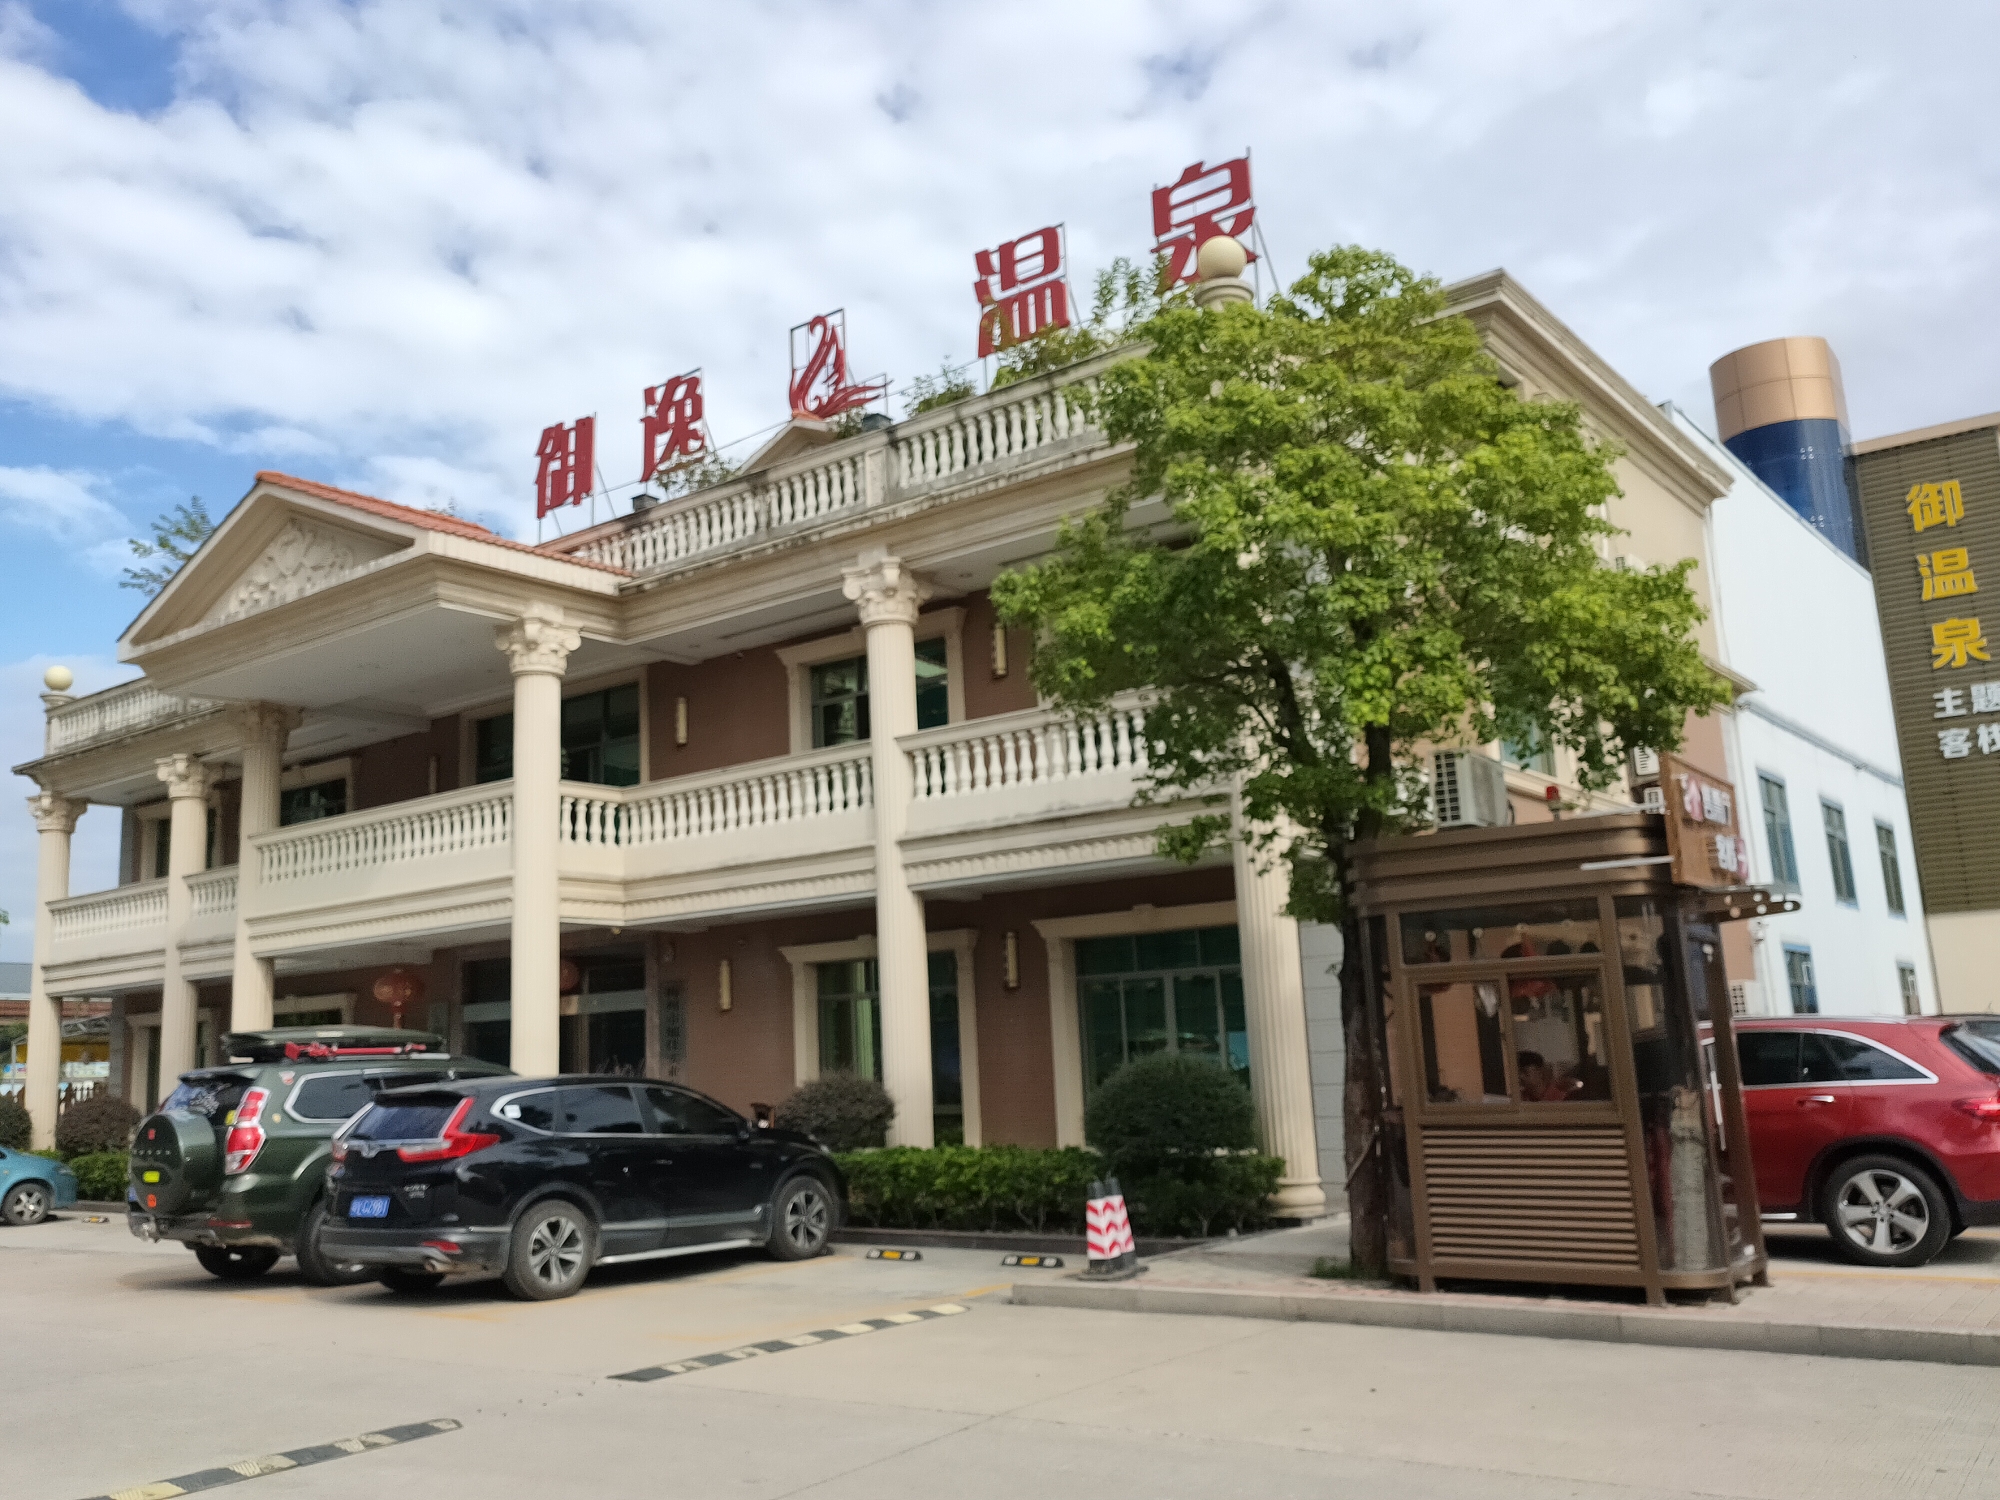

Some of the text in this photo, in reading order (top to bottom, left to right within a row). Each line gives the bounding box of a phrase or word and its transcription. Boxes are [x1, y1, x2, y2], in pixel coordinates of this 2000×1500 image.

[1906, 479, 1991, 669] 御温泉
[1932, 681, 2000, 719] 主题
